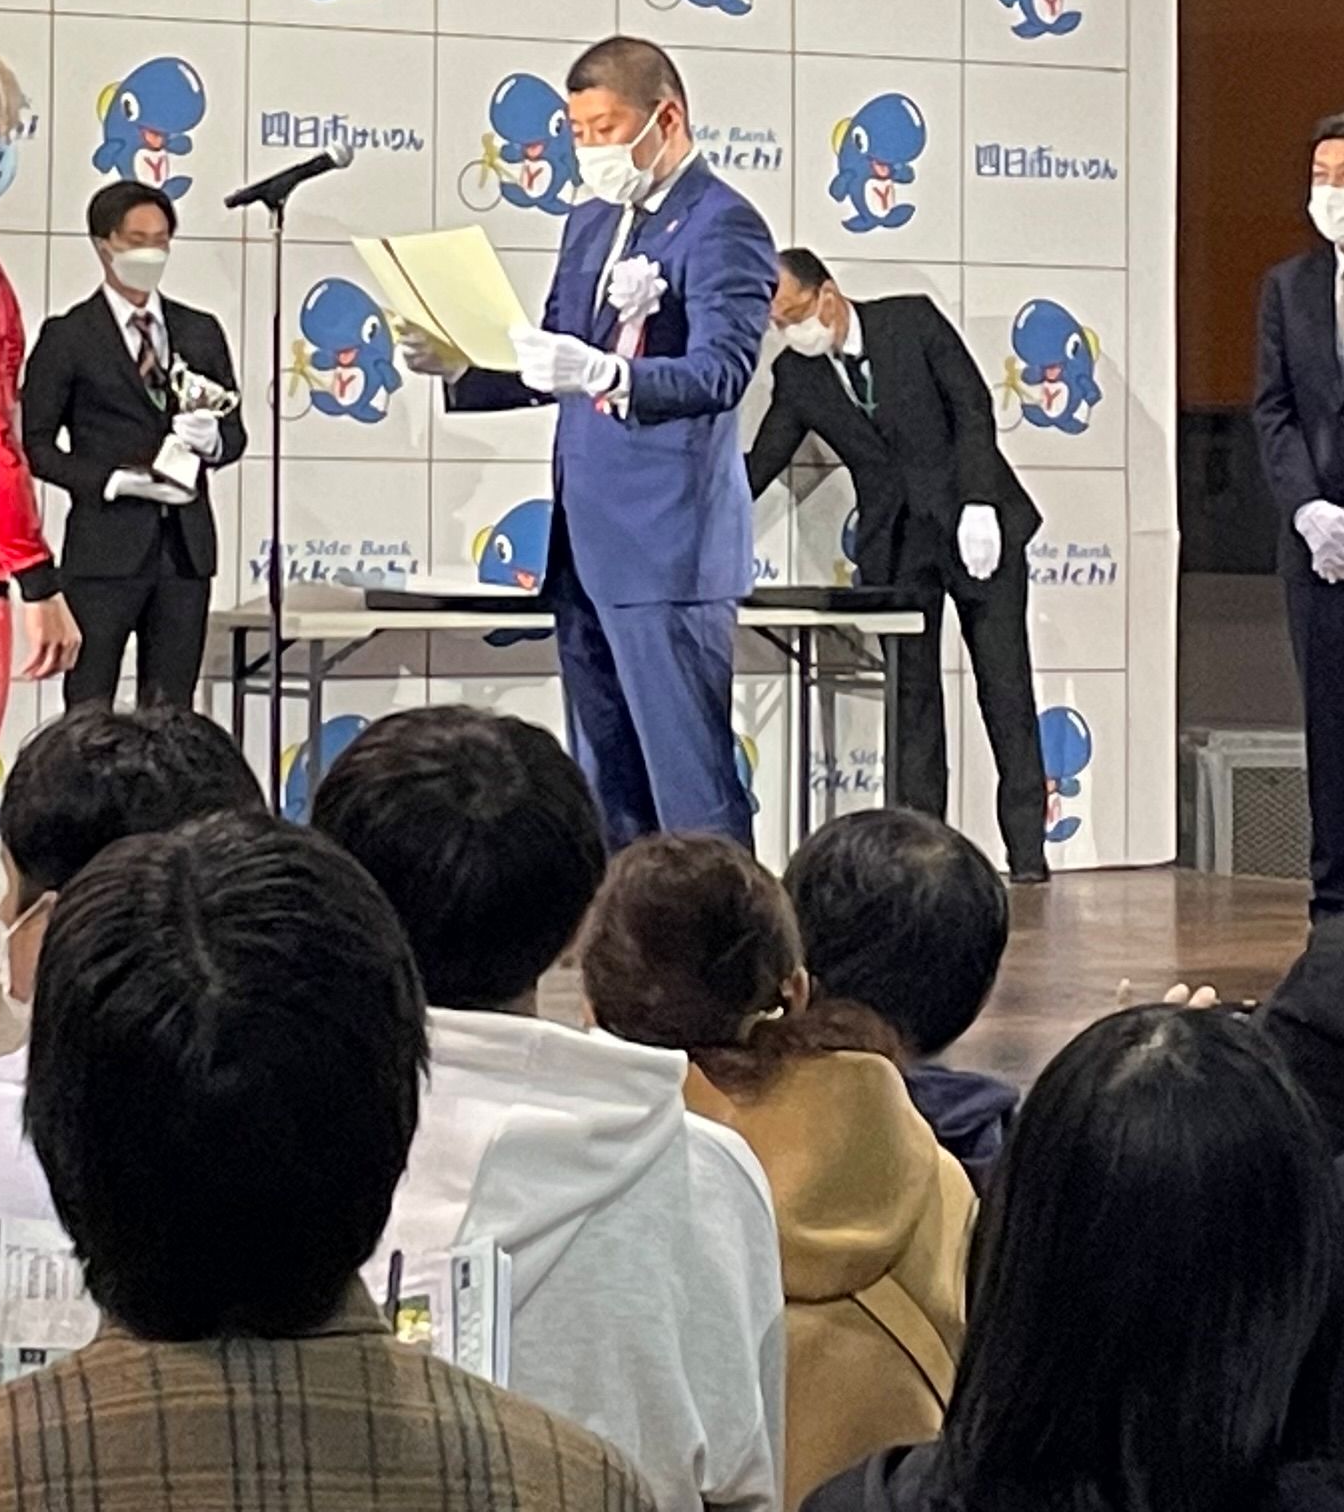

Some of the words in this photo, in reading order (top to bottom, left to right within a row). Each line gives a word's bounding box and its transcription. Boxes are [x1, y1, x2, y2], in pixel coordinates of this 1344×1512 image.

[729, 127, 777, 144] Bank
[144, 156, 164, 182] Y
[975, 144, 1117, 180] 四日市けいりん
[525, 165, 543, 189] Y
[873, 186, 890, 209] Y
[337, 373, 356, 398] Y
[1044, 387, 1061, 409] Y
[305, 540, 351, 556] Side
[360, 540, 412, 556] Bank
[1066, 543, 1112, 559] Bank
